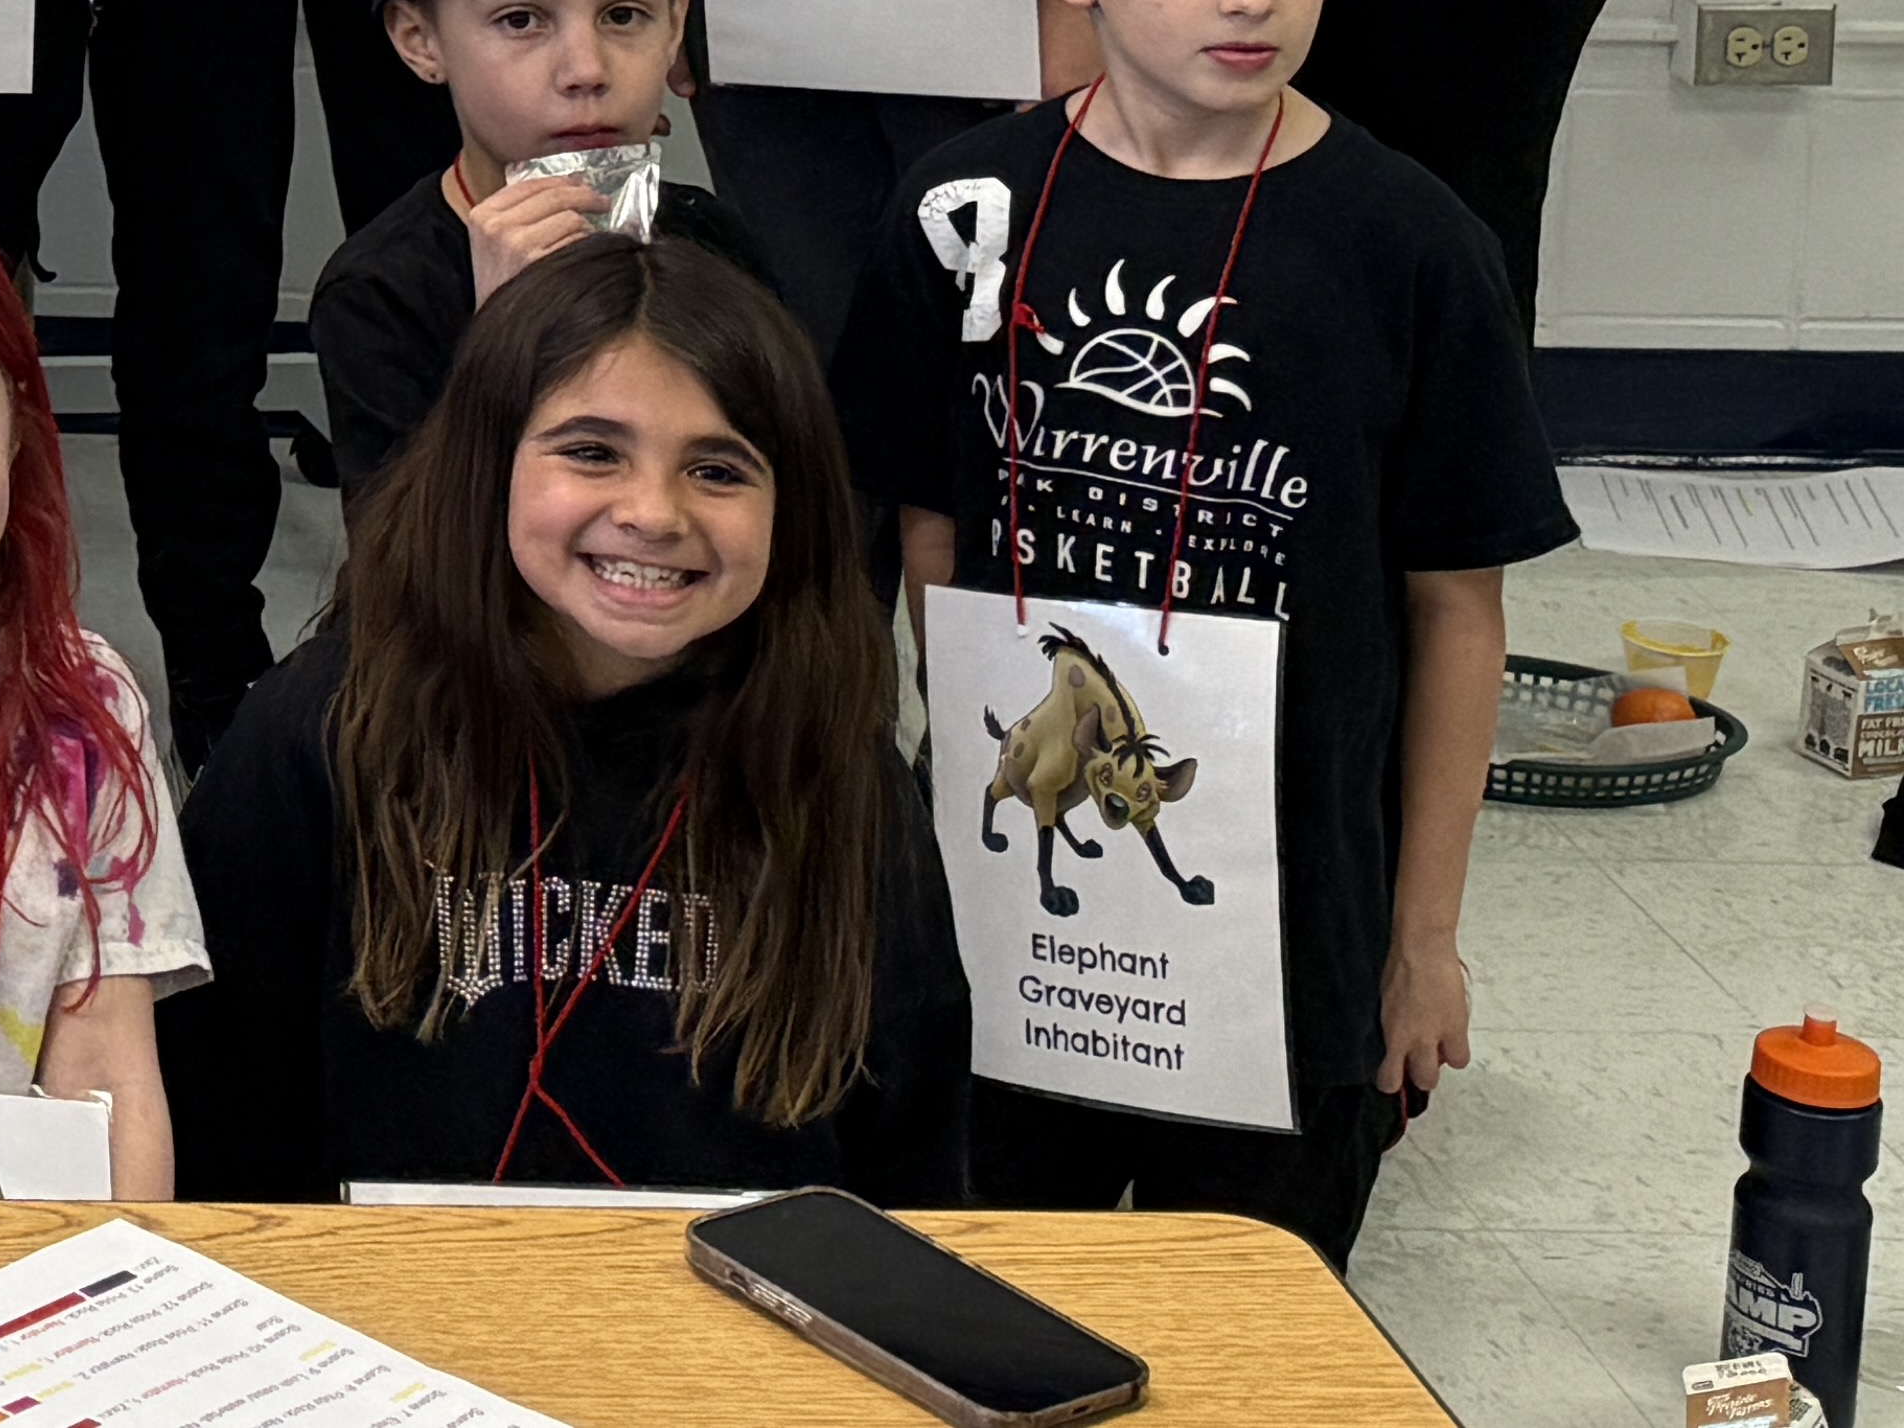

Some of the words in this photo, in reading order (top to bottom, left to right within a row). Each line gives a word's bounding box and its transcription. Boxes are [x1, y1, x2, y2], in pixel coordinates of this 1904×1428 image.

[972, 371, 1309, 509] Wrrenville
[1057, 505, 1133, 535] LEARN
[991, 517, 1291, 622] BSKETBALL
[436, 872, 719, 1007] WICKED
[1031, 932, 1170, 980] Elephant
[1019, 974, 1187, 1028] Graveyard
[1025, 1018, 1185, 1071] Inhabitant
